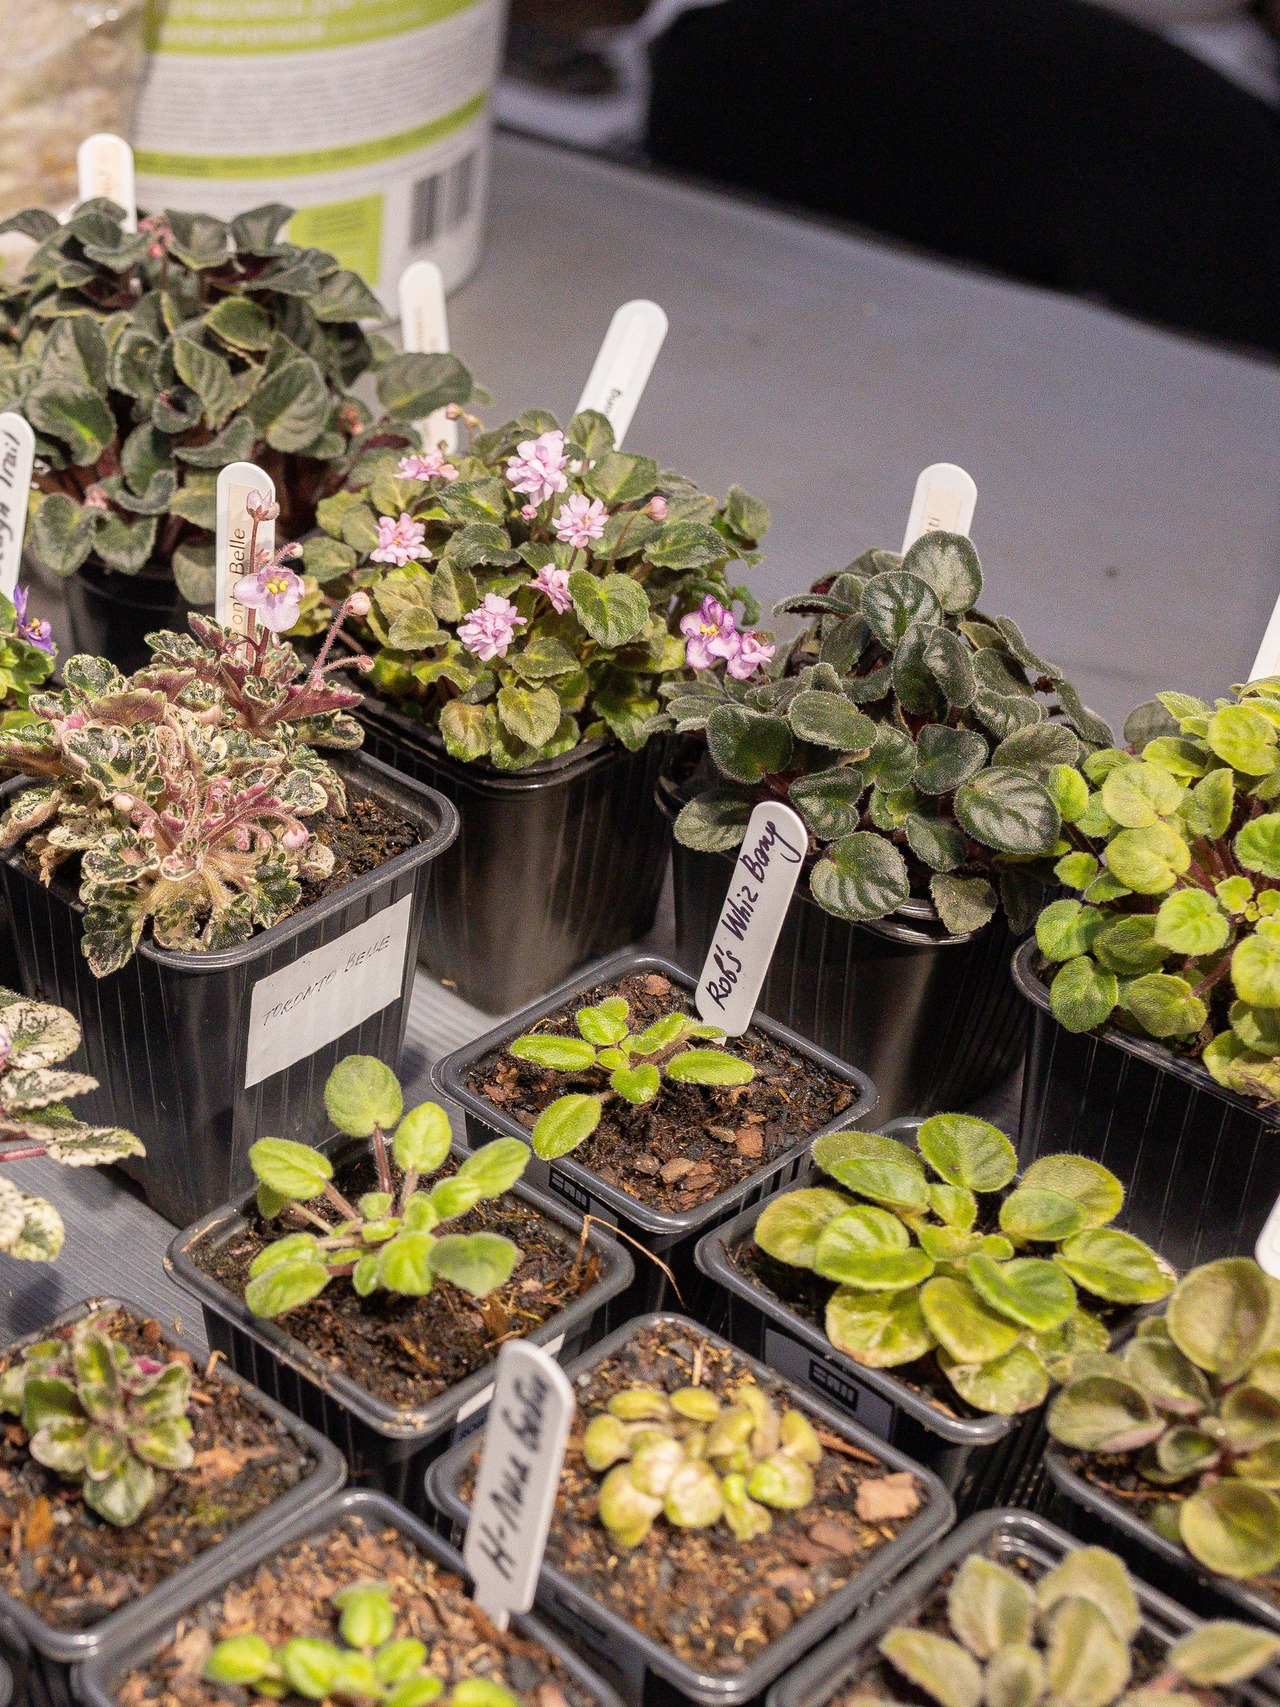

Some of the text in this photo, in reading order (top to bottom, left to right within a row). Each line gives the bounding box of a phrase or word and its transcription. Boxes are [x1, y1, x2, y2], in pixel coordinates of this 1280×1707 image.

[229, 528, 246, 575] Belle
[721, 885, 758, 942] Whiz
[263, 935, 391, 1026] TORONTO BELLE
[705, 944, 742, 1011] Rob's
